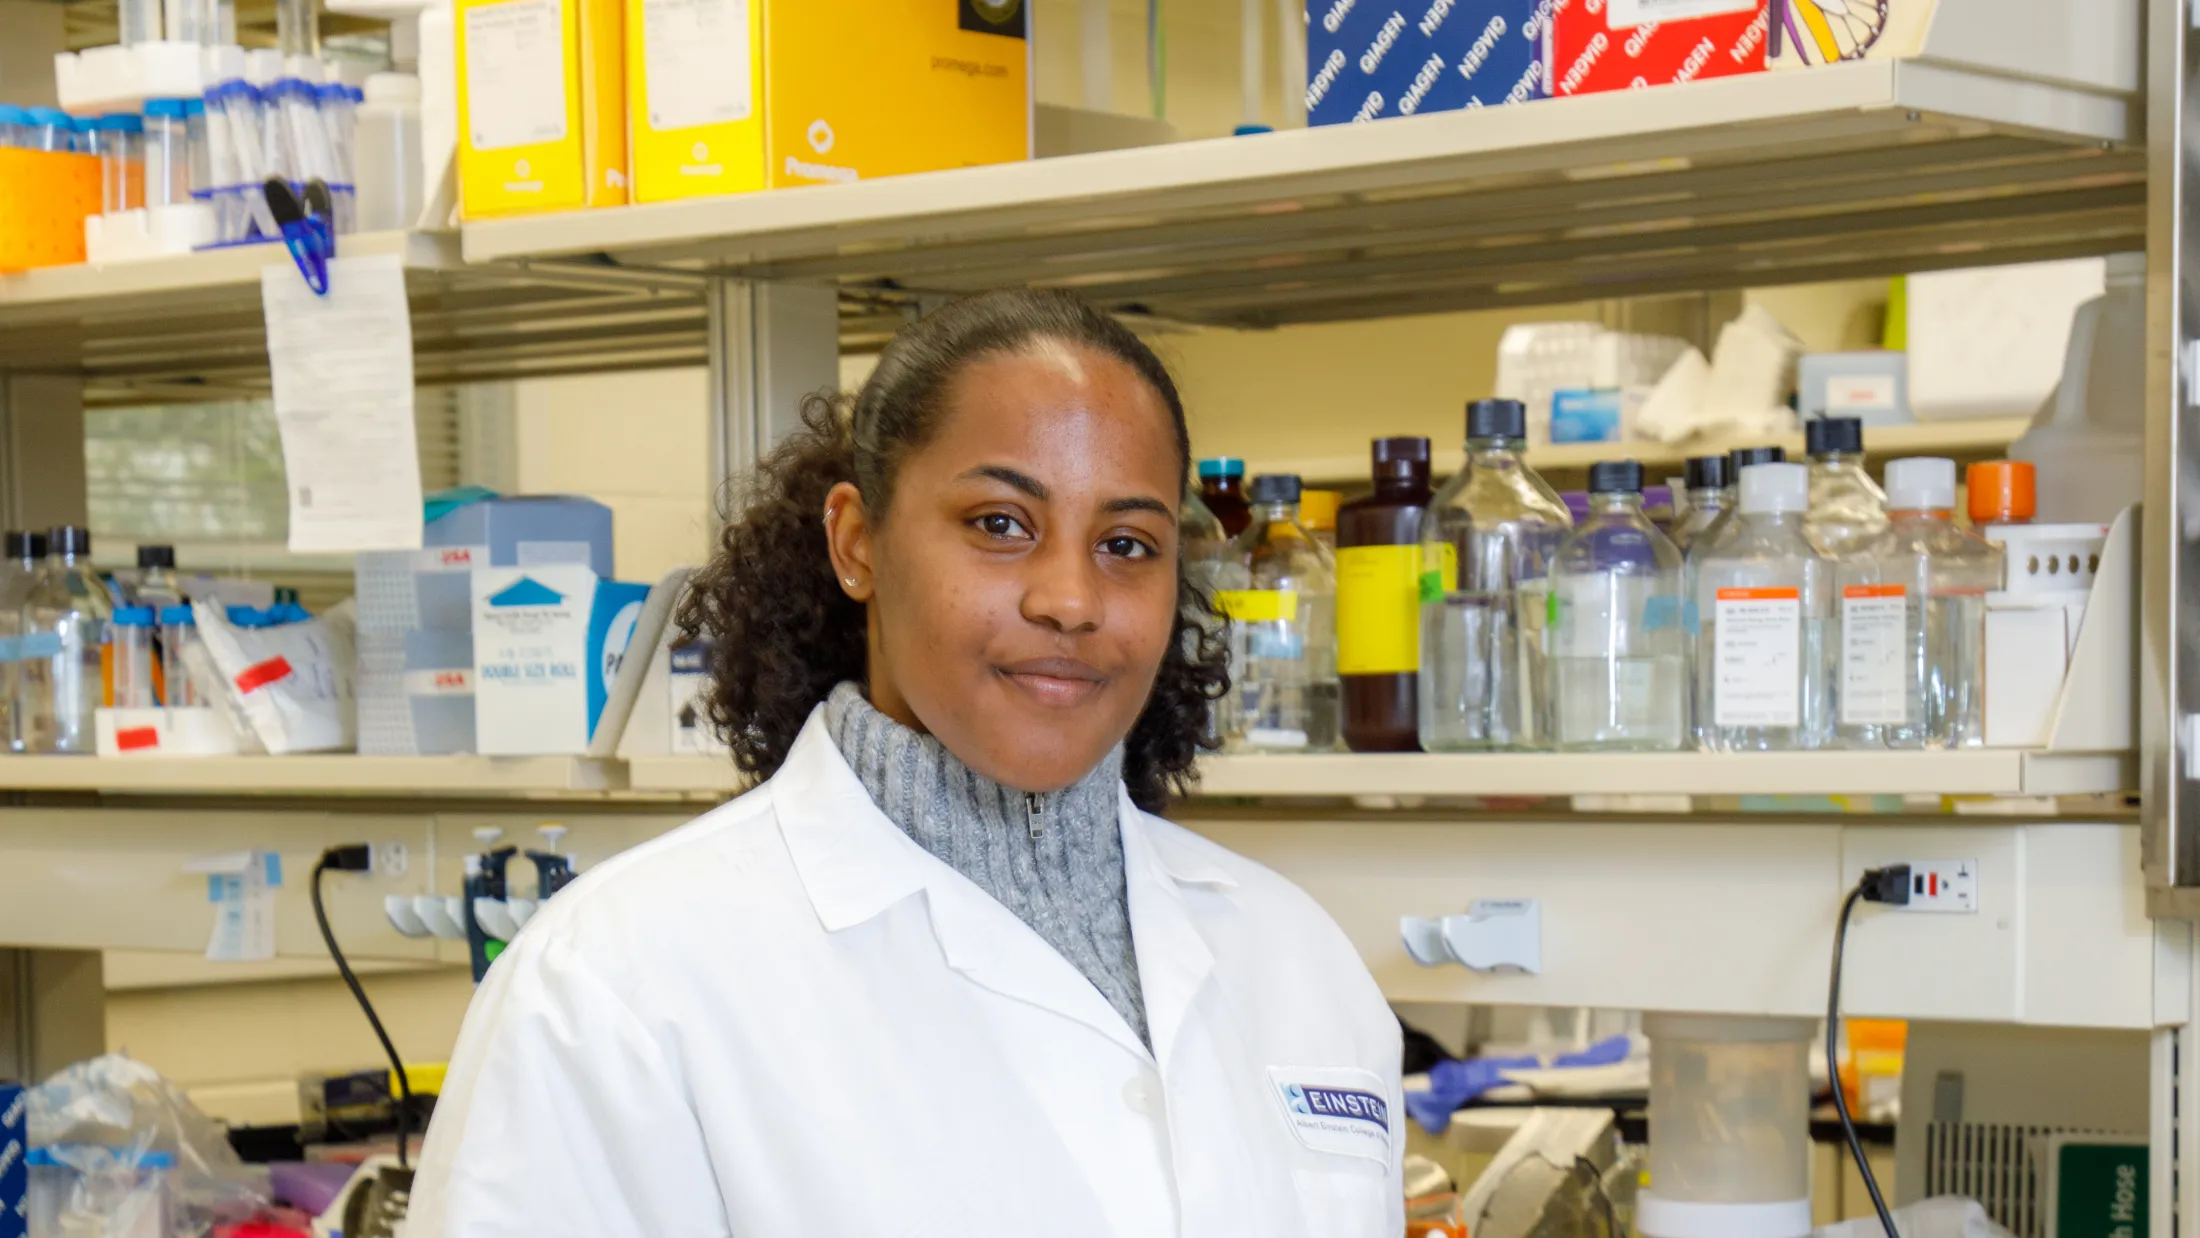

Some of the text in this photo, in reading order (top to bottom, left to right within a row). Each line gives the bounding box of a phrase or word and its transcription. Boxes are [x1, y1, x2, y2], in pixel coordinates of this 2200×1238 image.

[1360, 11, 1407, 75] QIAGEN
[1398, 53, 1445, 116] QIAGEN
[1296, 1119, 1319, 1130] Albert
[2110, 1164, 2136, 1221] Hose
